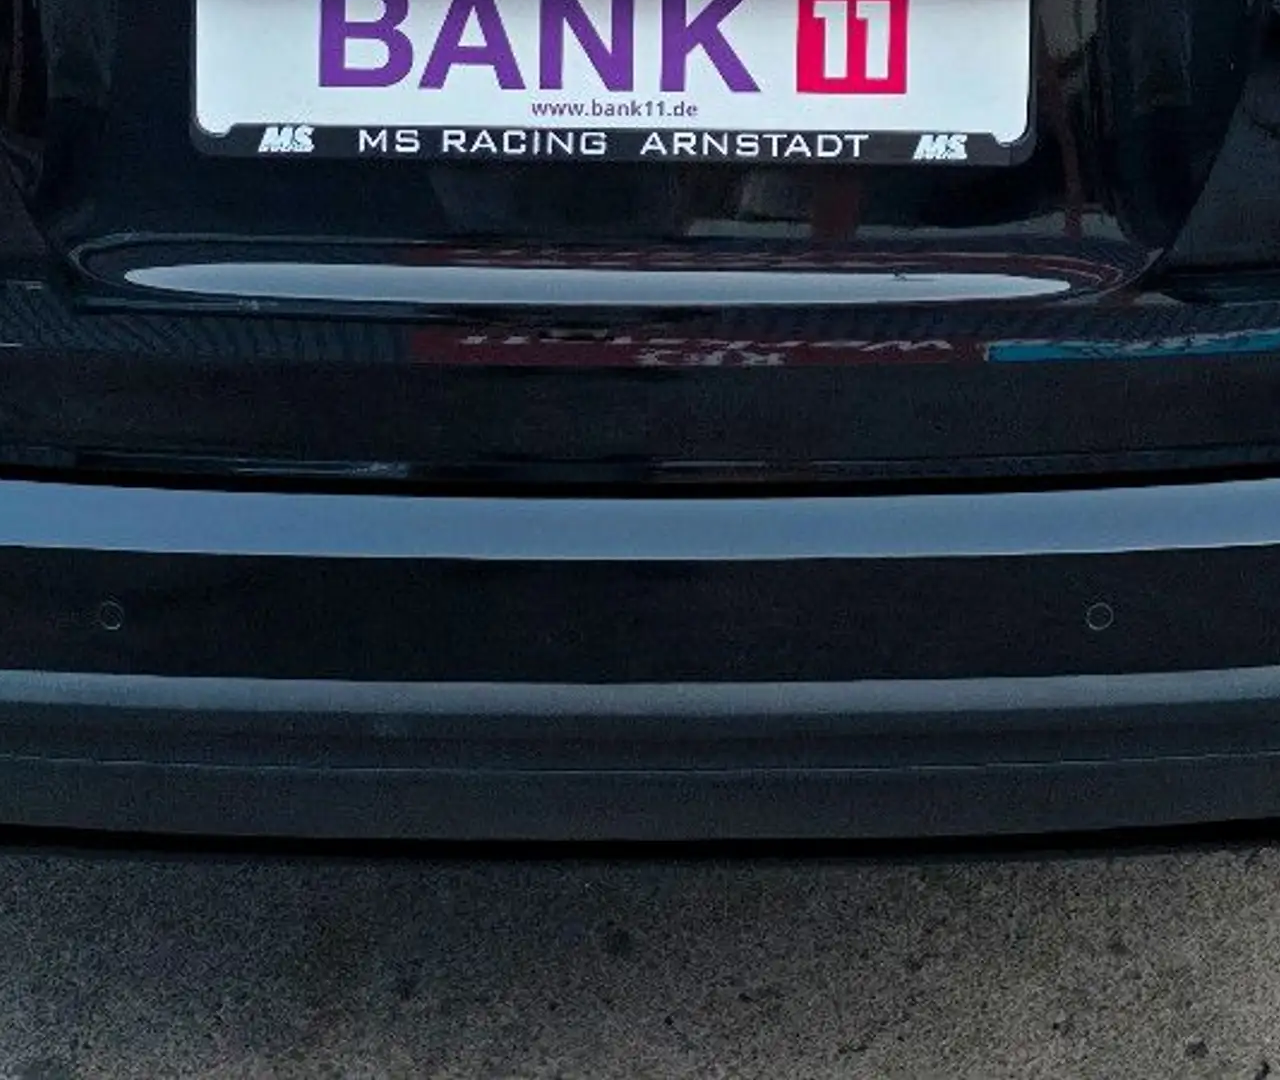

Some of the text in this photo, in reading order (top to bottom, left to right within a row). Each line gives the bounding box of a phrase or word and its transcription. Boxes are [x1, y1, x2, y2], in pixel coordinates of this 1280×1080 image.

[531, 99, 698, 119] www.bank11.de
[358, 129, 420, 152] MS
[442, 129, 608, 156] RACING
[640, 133, 869, 157] ARNSTADT
